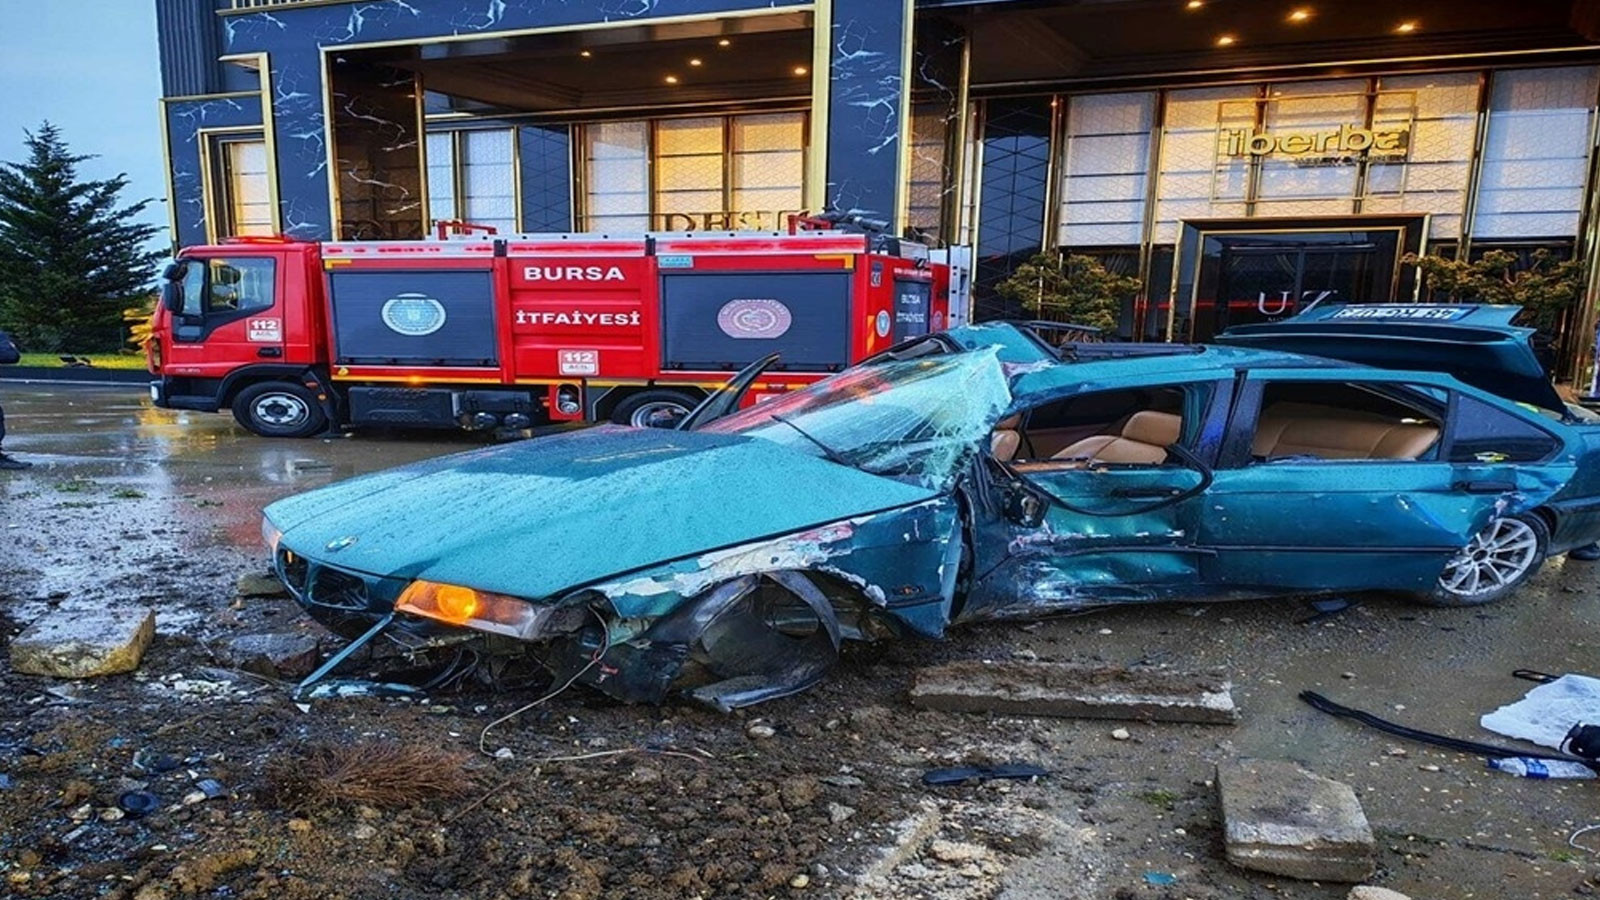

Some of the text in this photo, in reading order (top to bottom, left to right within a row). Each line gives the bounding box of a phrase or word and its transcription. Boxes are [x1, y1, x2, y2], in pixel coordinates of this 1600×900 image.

[523, 267, 626, 281] BURSA
[516, 309, 641, 325] İTFAİYESİ
[251, 320, 277, 329] 112
[564, 352, 594, 362] 112
